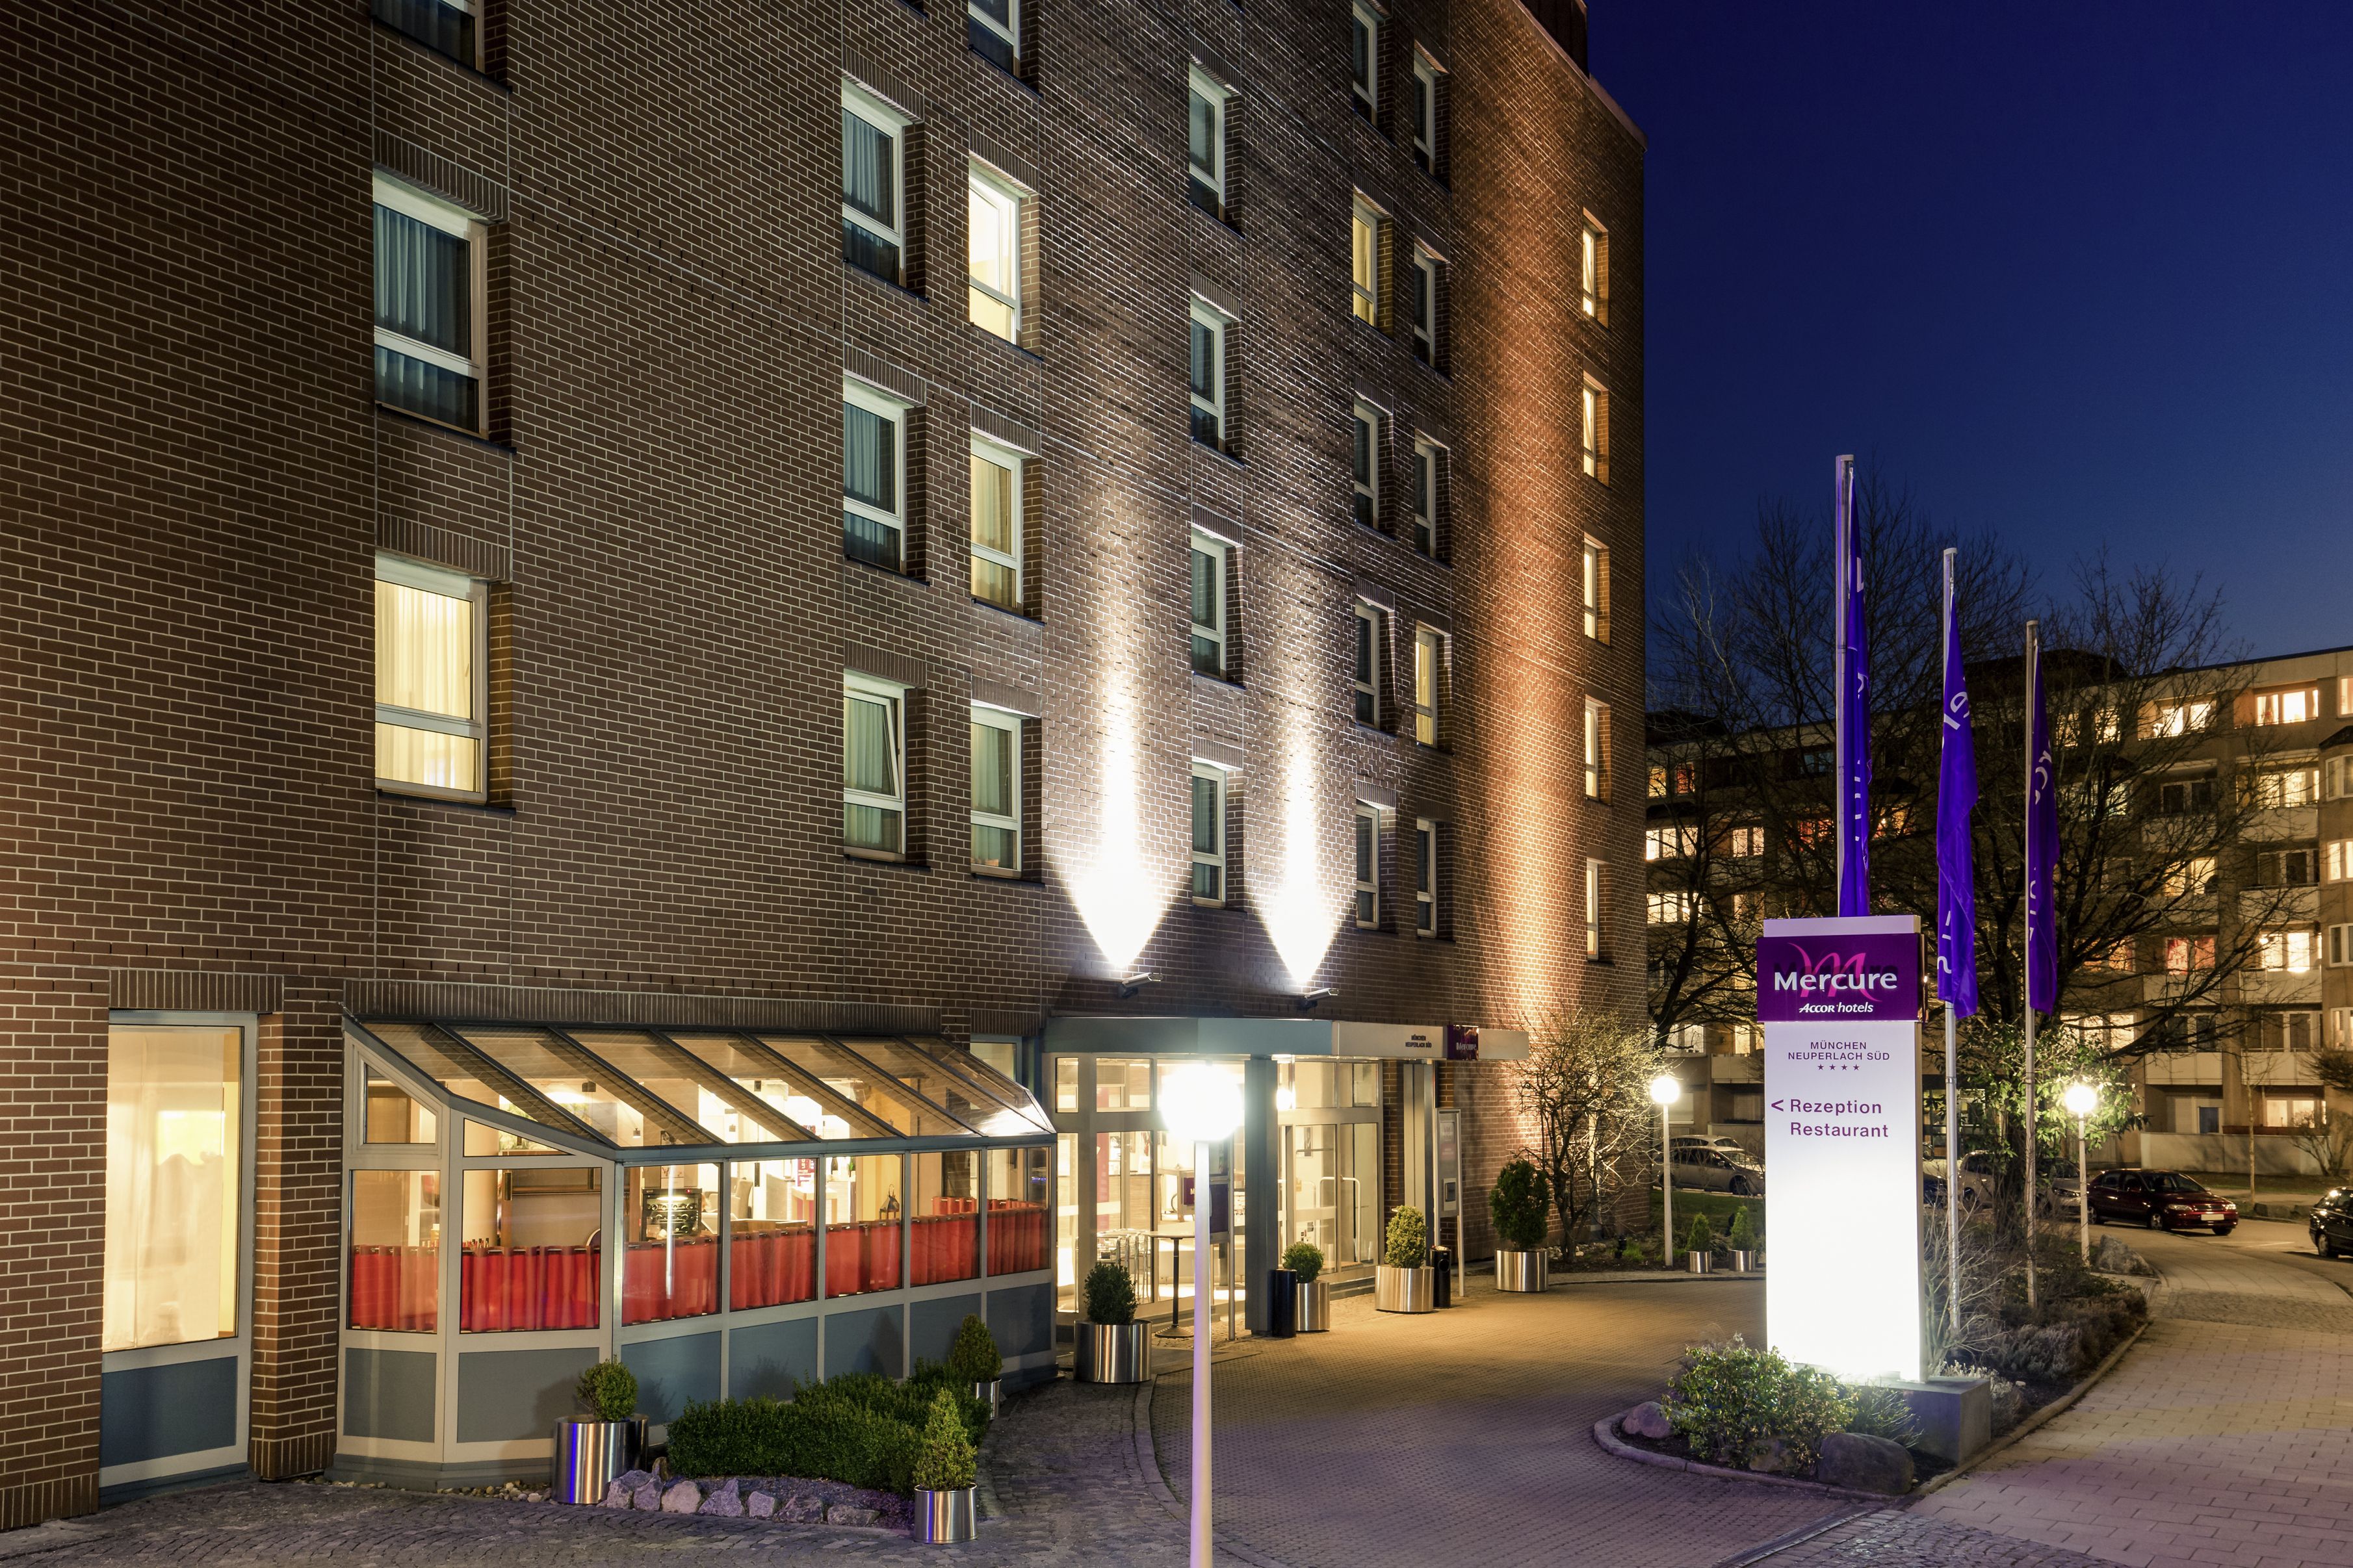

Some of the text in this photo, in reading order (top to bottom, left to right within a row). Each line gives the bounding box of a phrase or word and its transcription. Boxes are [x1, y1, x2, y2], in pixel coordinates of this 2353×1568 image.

[1774, 971, 1897, 990] Mercure
[1838, 1001, 1874, 1012] hotels
[1810, 1040, 1867, 1050] MÜNCHEN
[1788, 1050, 1890, 1060] NEUPERLACH SÜD
[1790, 1098, 1882, 1116] Rezeption
[1790, 1122, 1888, 1138] Restaurant
